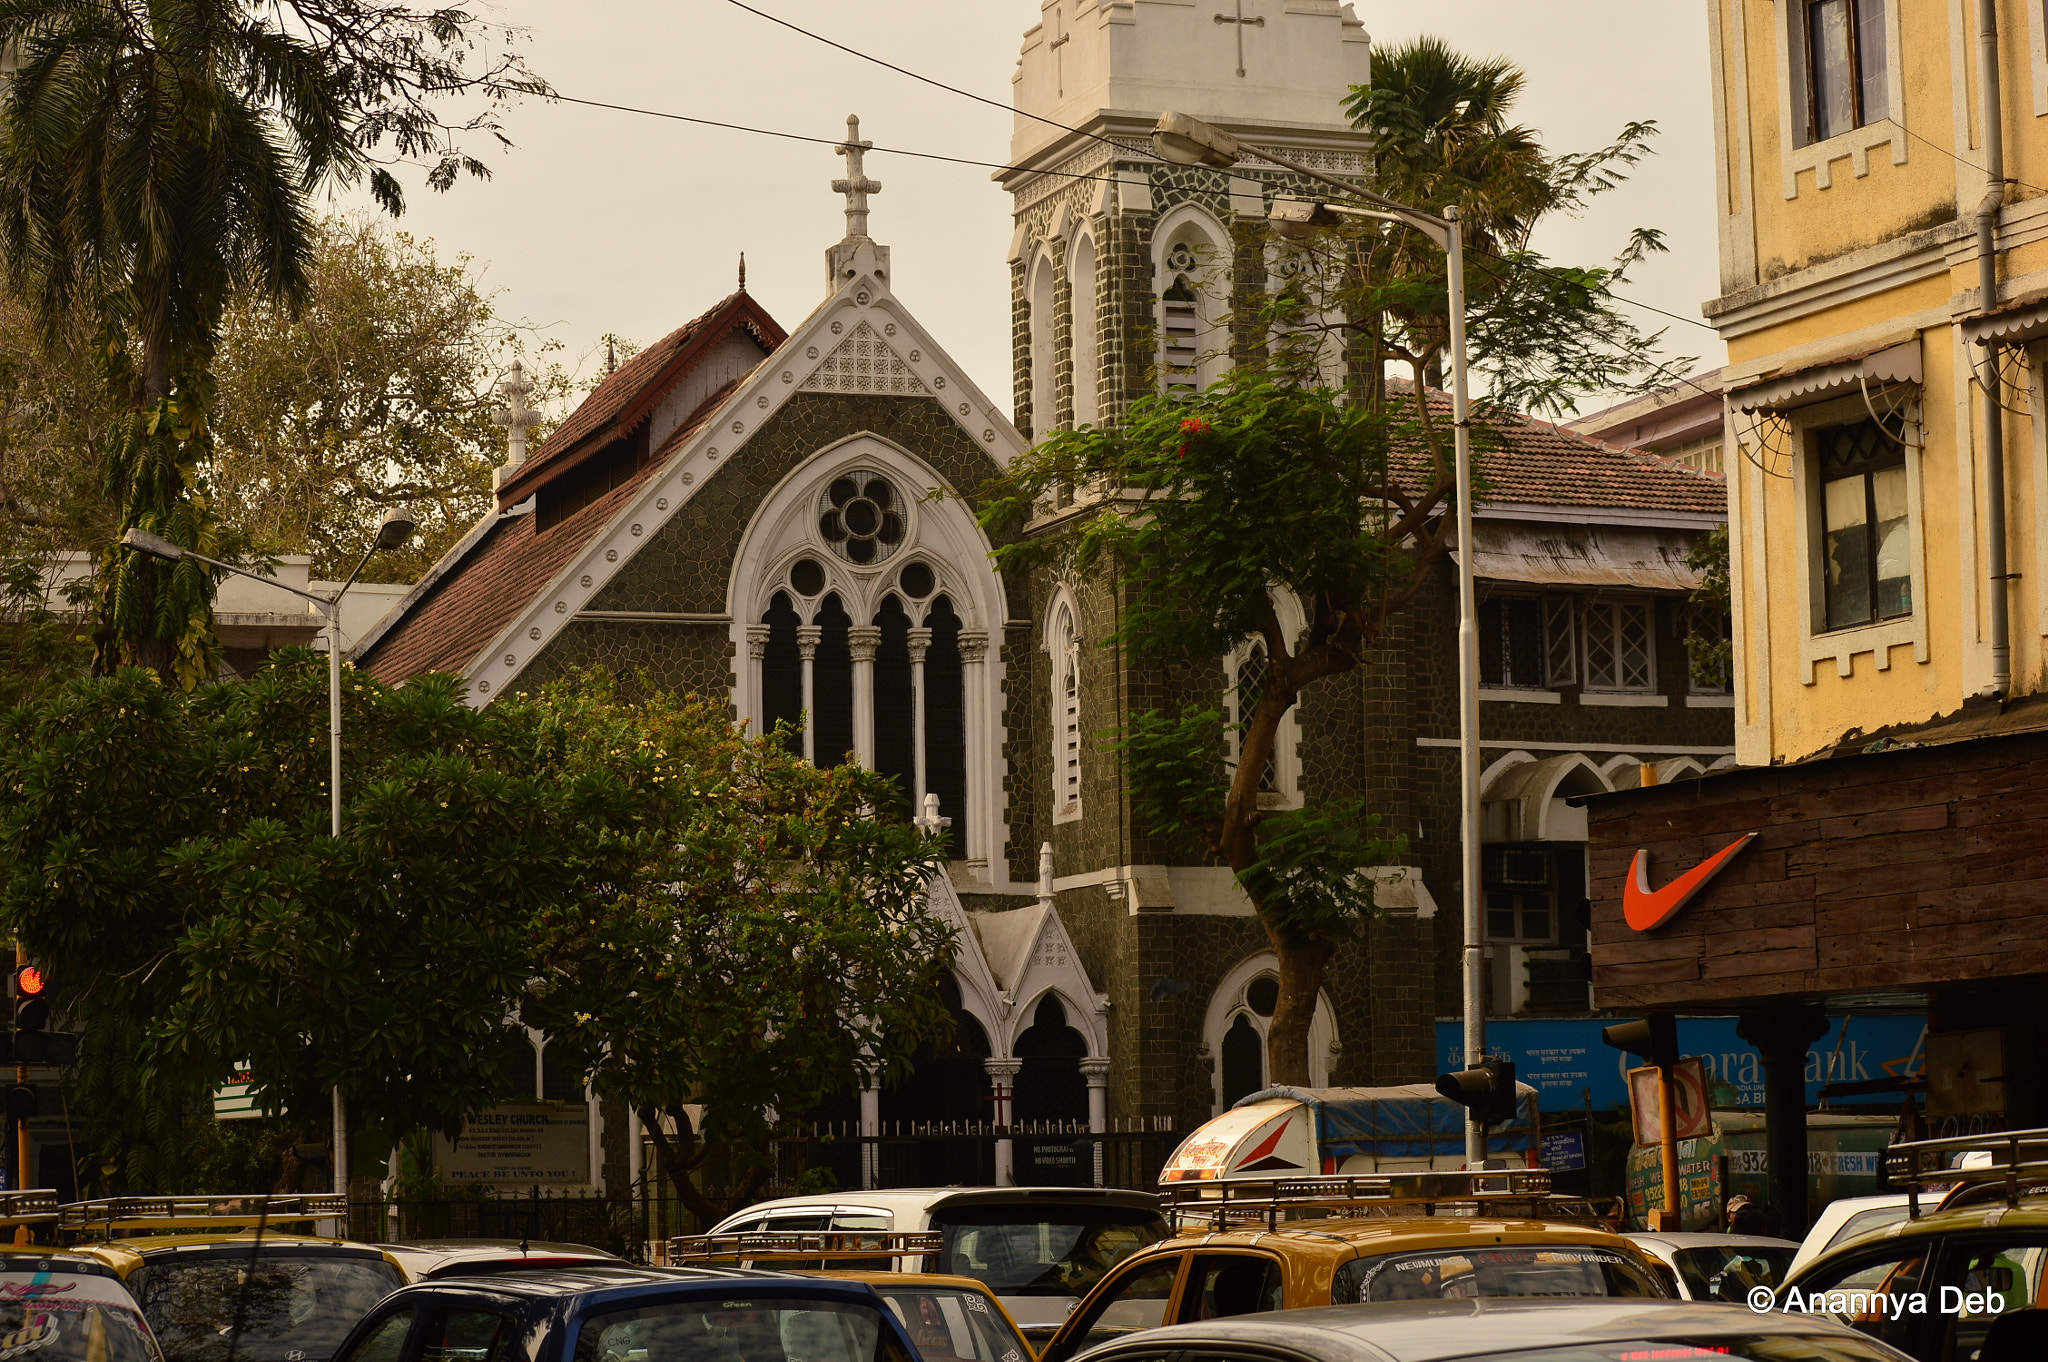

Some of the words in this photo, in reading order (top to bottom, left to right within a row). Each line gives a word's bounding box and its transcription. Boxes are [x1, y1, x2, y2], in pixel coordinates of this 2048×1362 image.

[1803, 1039, 1871, 1082] ank
[467, 1115, 508, 1125] WESLEY
[510, 1115, 547, 1125] CHURCH
[917, 1125, 990, 1136] WESLEY
[1014, 1125, 1087, 1136] CHURCH
[1034, 1145, 1041, 1153] NO
[1035, 1157, 1042, 1165] NO
[1042, 1157, 1055, 1165] VIDEO
[1679, 1160, 1711, 1176] WATER
[451, 1170, 490, 1178] PEACE
[493, 1170, 510, 1178] BE
[513, 1170, 544, 1178] UNTO
[547, 1170, 568, 1178] YOU
[607, 1336, 631, 1347] CNG
